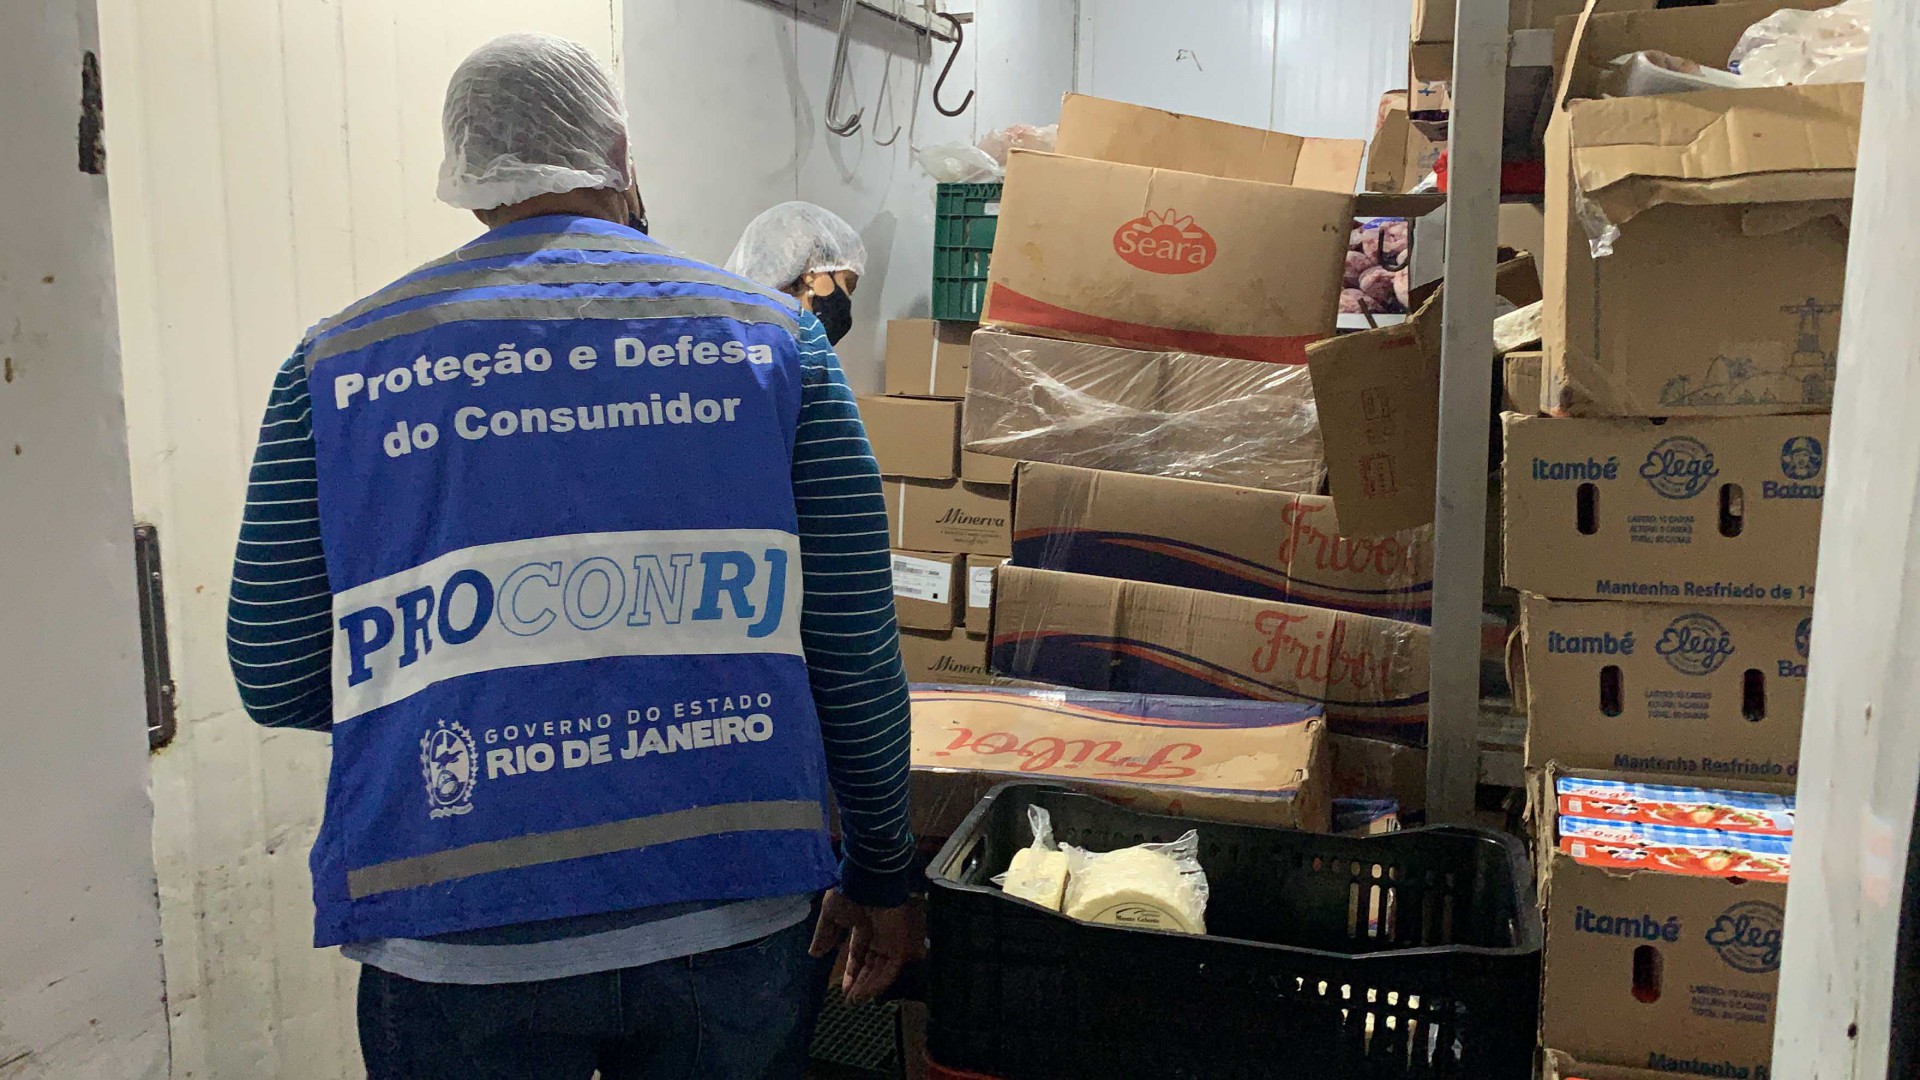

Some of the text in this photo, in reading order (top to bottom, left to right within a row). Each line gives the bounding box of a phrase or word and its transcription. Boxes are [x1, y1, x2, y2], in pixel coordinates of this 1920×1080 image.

[1119, 230, 1207, 265] Seara
[334, 336, 773, 409] Proteção e Defesa
[383, 393, 742, 458] do Consumidor
[1532, 456, 1620, 481] itambé
[1762, 480, 1824, 499] Batav
[936, 507, 1005, 527] Minerva
[1596, 579, 1680, 597] Mantenha
[1684, 581, 1766, 599] Resfriado
[1770, 584, 1793, 599] de
[927, 655, 985, 675] Minerv
[1548, 630, 1636, 656] itambé
[485, 692, 772, 744] GOVERNO DO ESTADO
[486, 713, 774, 779] RIO DE JANEIRO
[935, 727, 1203, 779] Friboi
[1574, 905, 1782, 965] itambé Eleg
